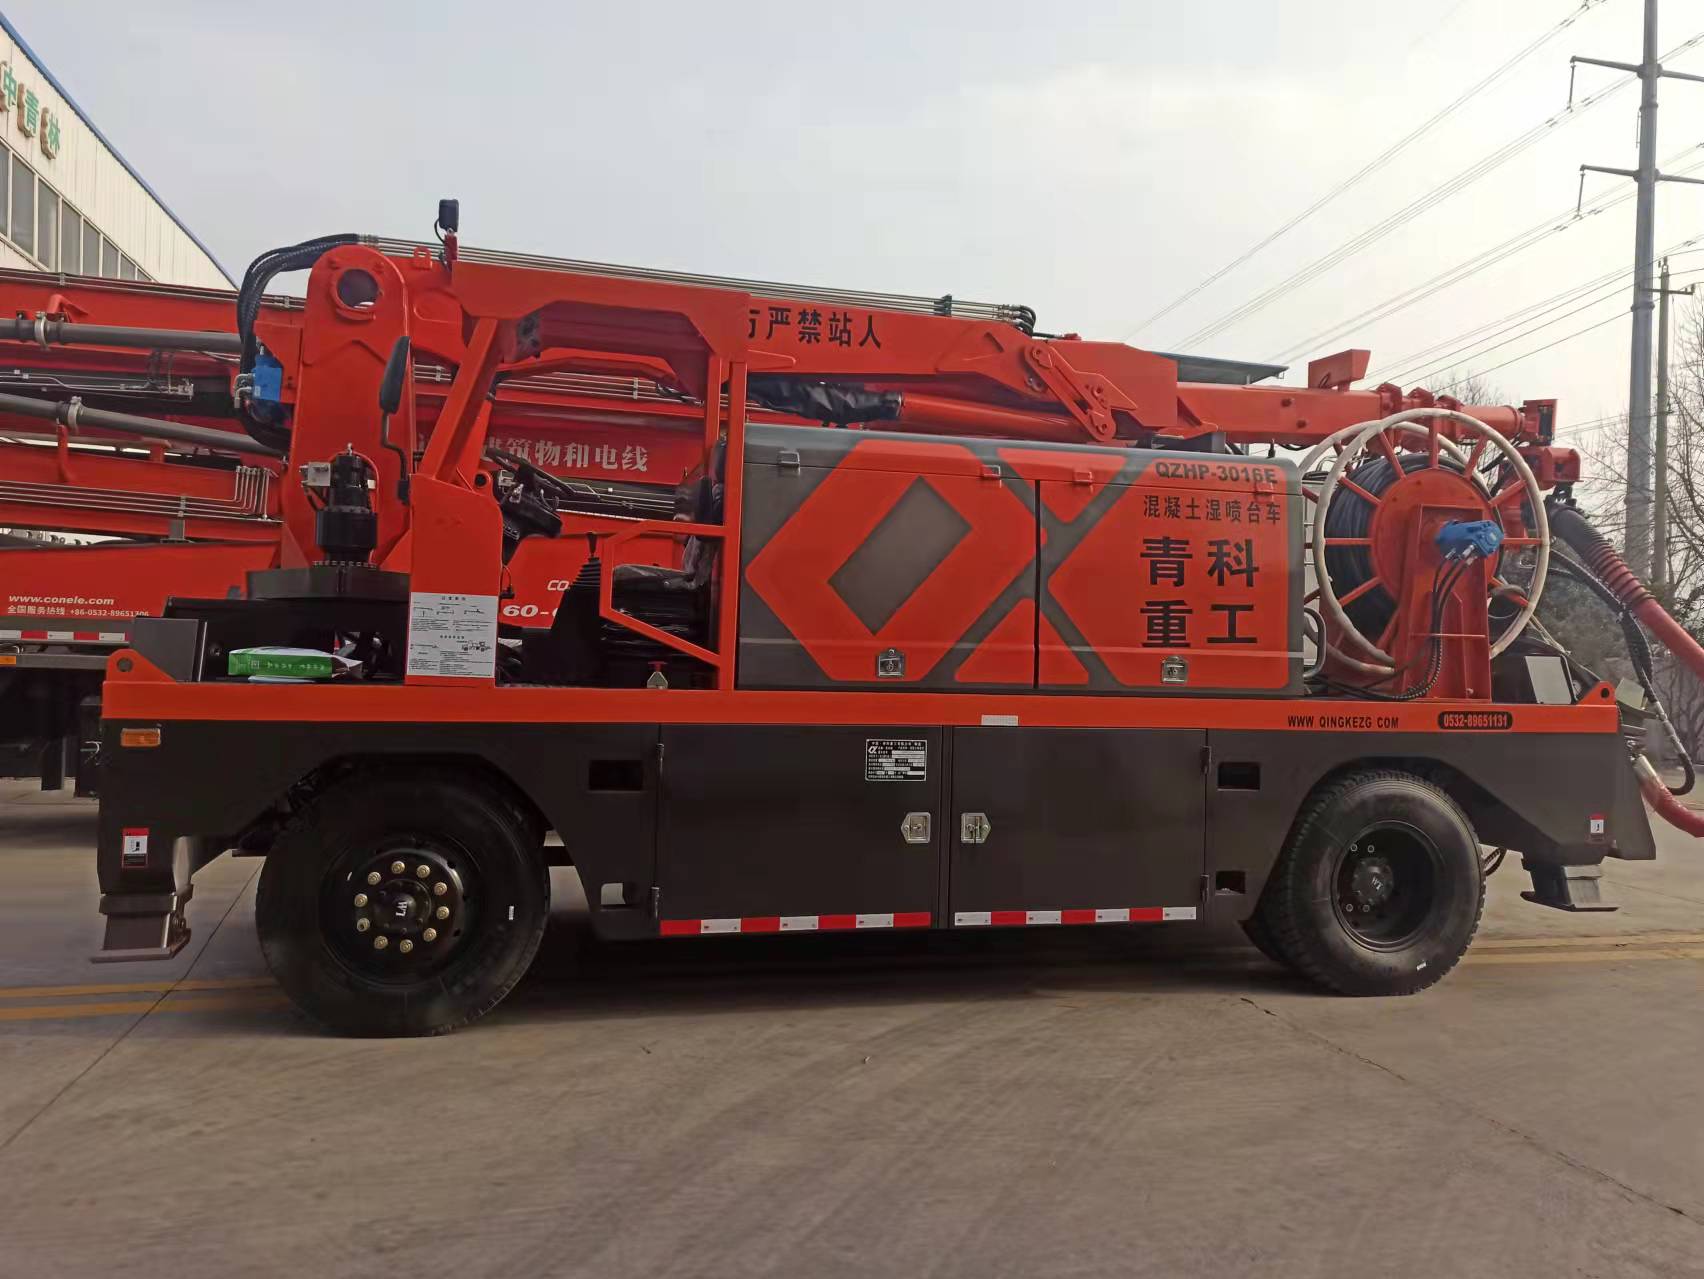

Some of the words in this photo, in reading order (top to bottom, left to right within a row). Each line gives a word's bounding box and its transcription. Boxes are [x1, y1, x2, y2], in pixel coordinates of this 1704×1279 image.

[1143, 494, 1281, 526] 混凝土湿喷台车
[1140, 536, 1260, 588] 青科
[8, 594, 115, 606] www.conele.com
[547, 579, 570, 591] CO
[1140, 599, 1258, 648] 重工
